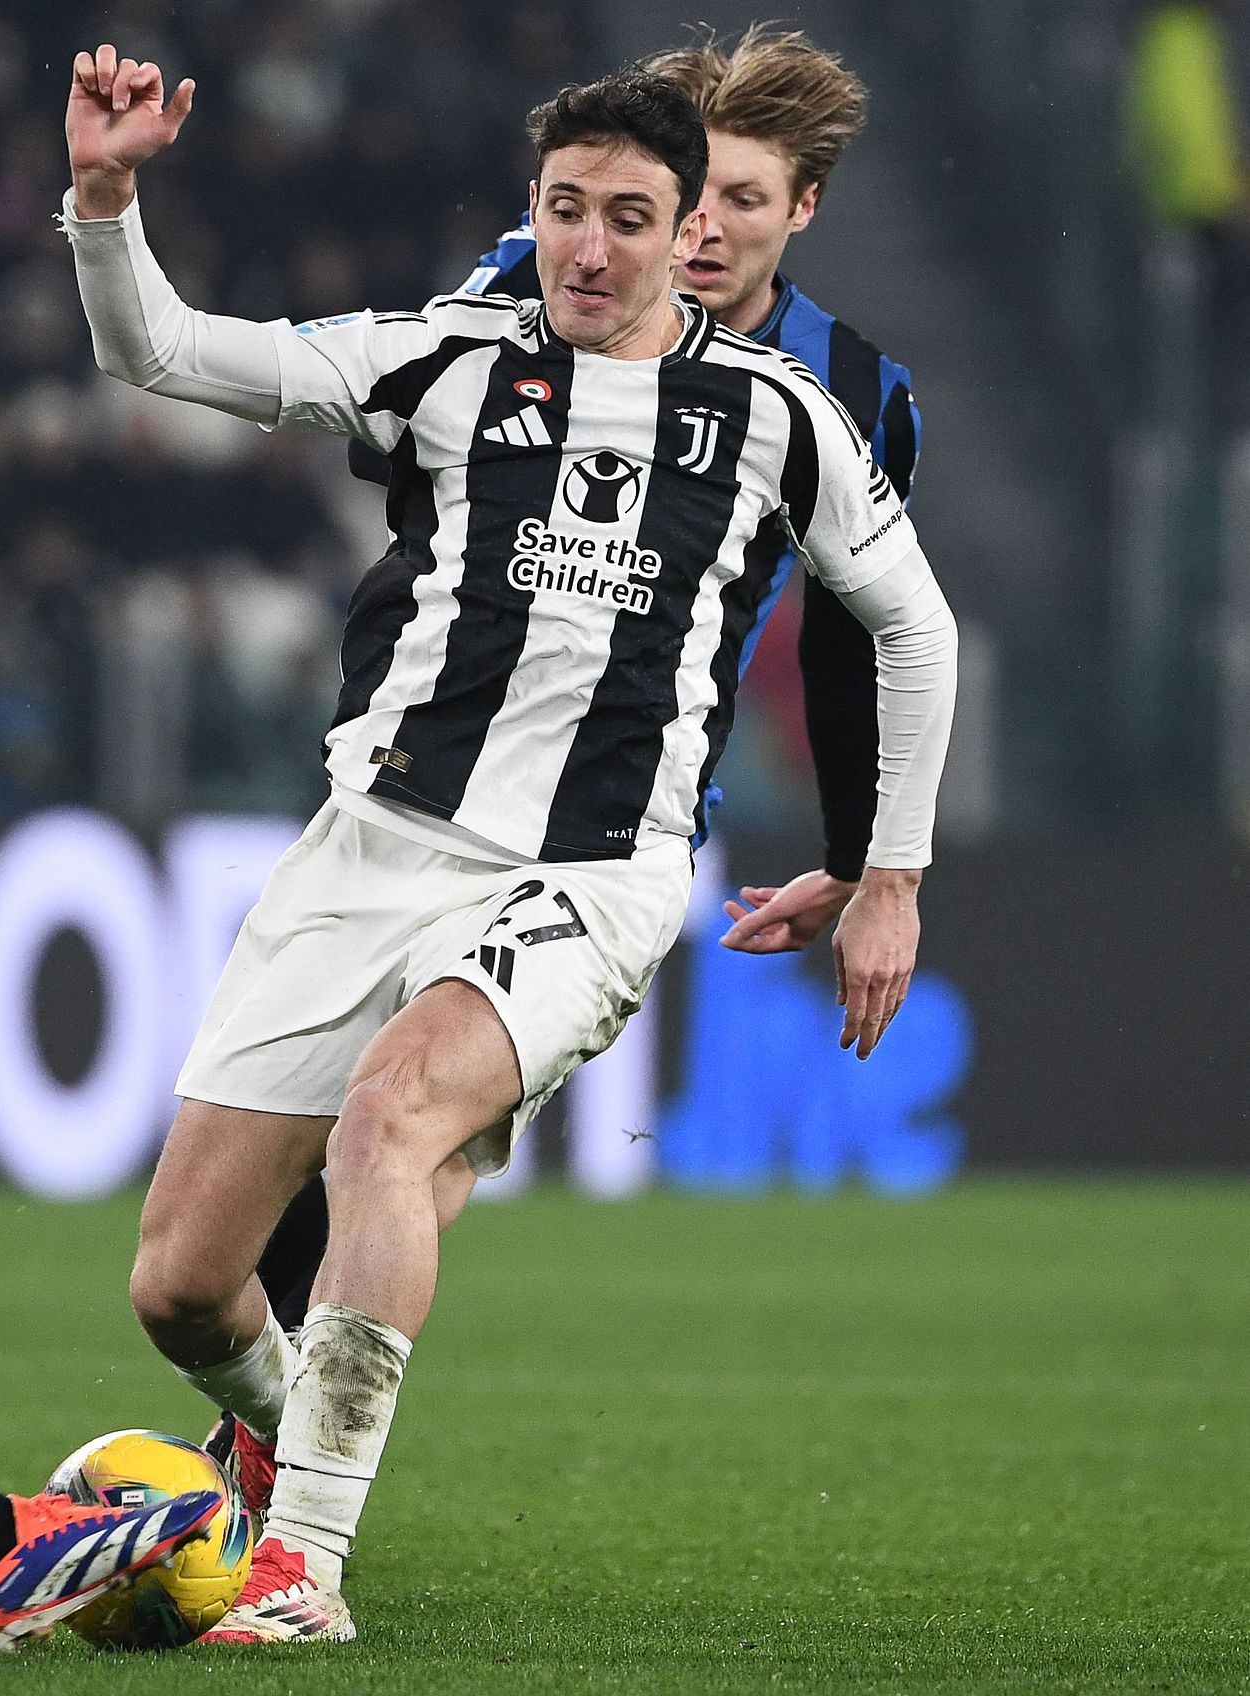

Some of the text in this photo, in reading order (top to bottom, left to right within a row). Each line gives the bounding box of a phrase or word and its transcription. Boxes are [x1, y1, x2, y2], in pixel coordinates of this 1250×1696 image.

[518, 522, 657, 574] Save the
[512, 558, 649, 610] Children
[482, 879, 589, 947] 27
